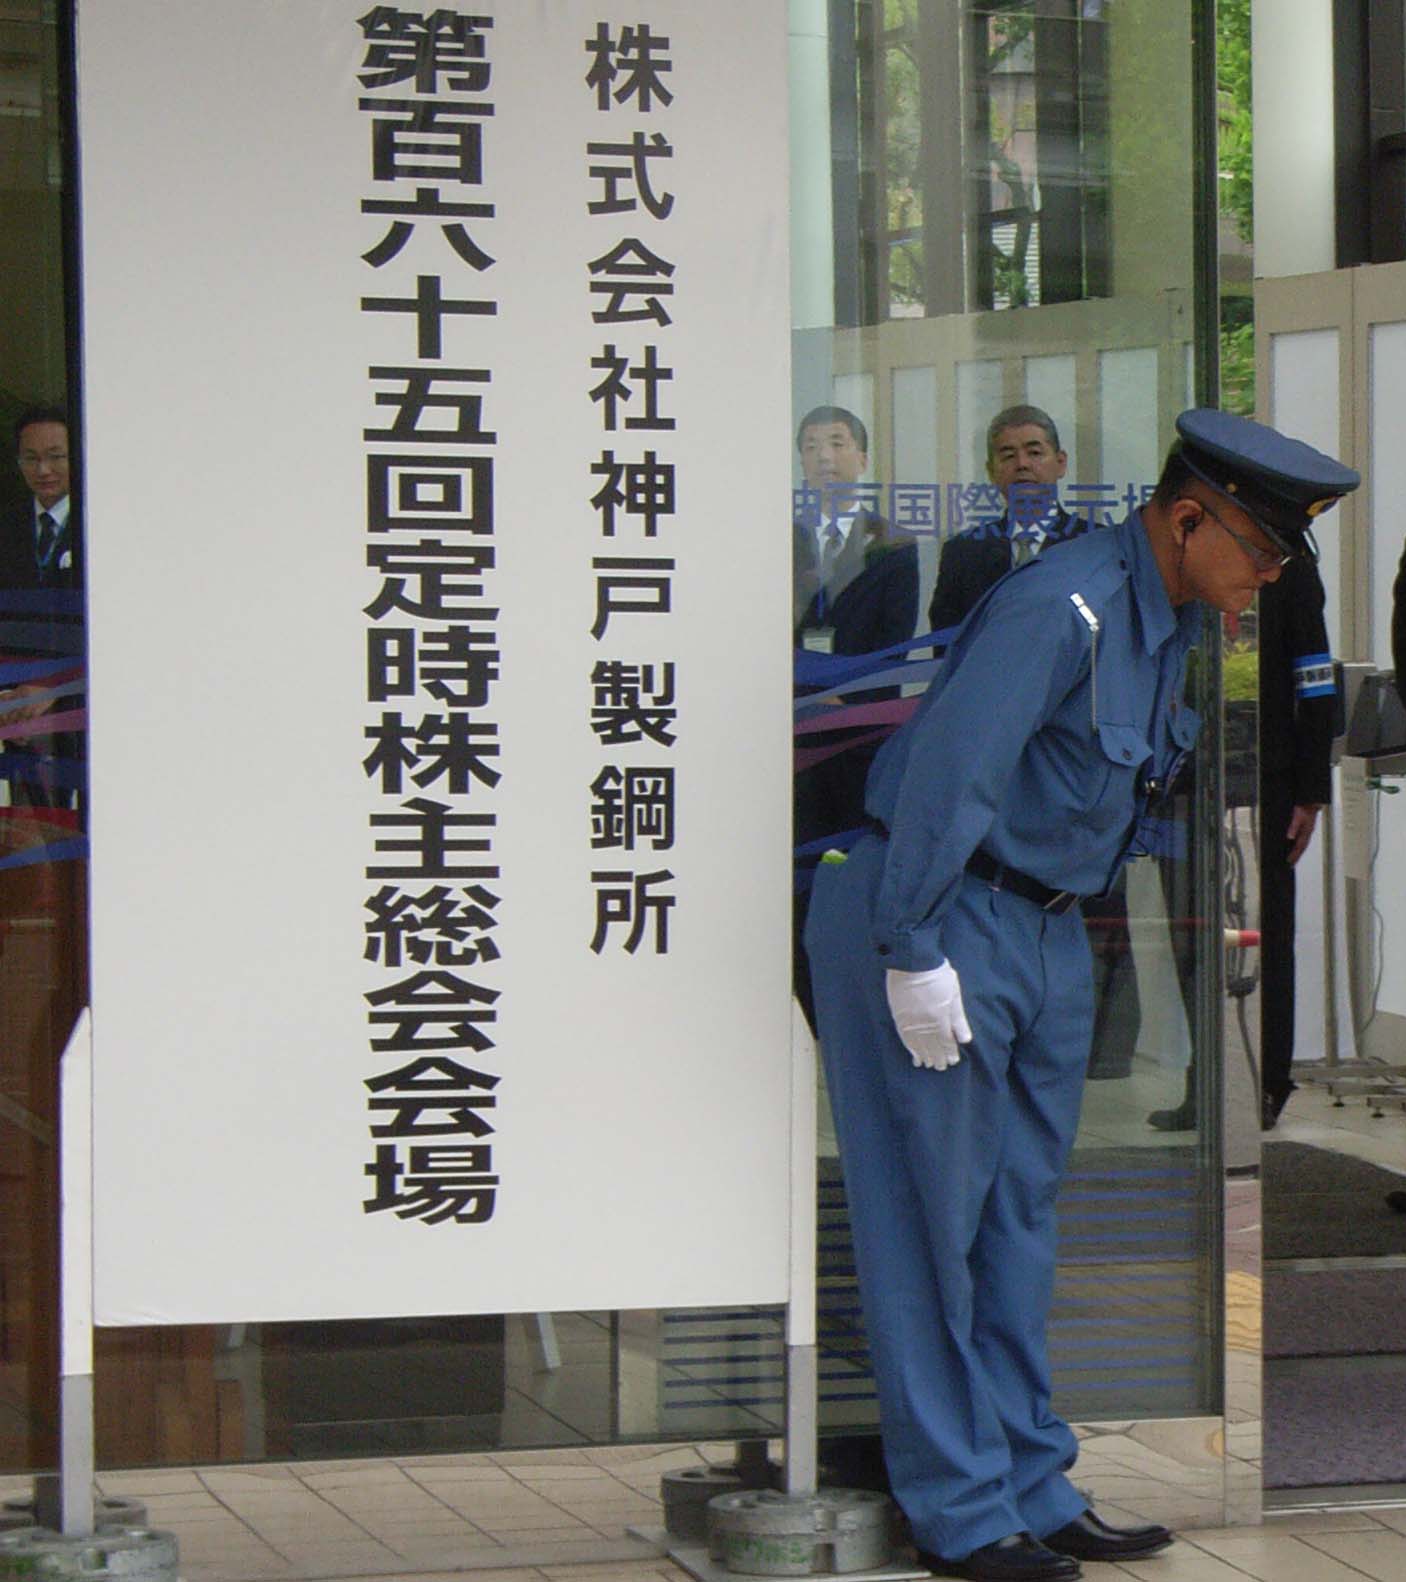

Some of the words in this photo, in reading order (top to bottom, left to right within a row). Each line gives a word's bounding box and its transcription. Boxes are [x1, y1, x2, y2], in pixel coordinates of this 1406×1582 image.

[356, 5, 502, 1226] 第百六十五回定時株主総会会場
[584, 22, 678, 956] 株式会社神戸製鋼所
